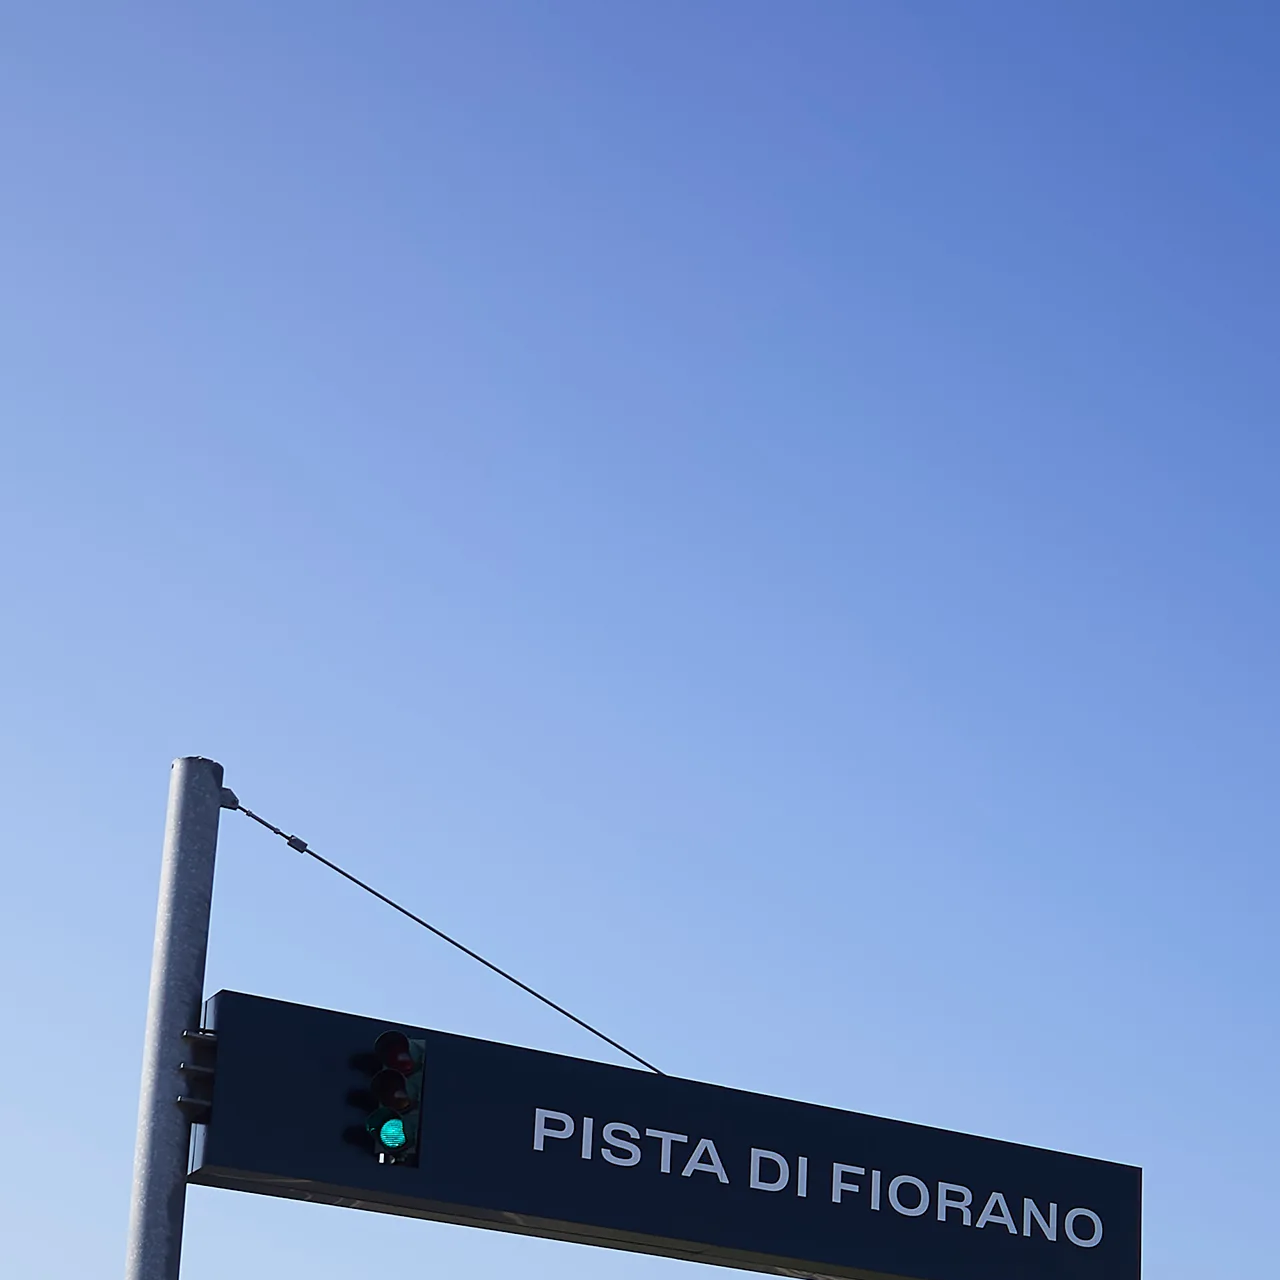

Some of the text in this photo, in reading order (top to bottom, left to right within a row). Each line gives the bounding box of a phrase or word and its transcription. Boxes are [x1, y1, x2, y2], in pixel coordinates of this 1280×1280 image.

[533, 1108, 1104, 1248] PISTA DI FIORANO
